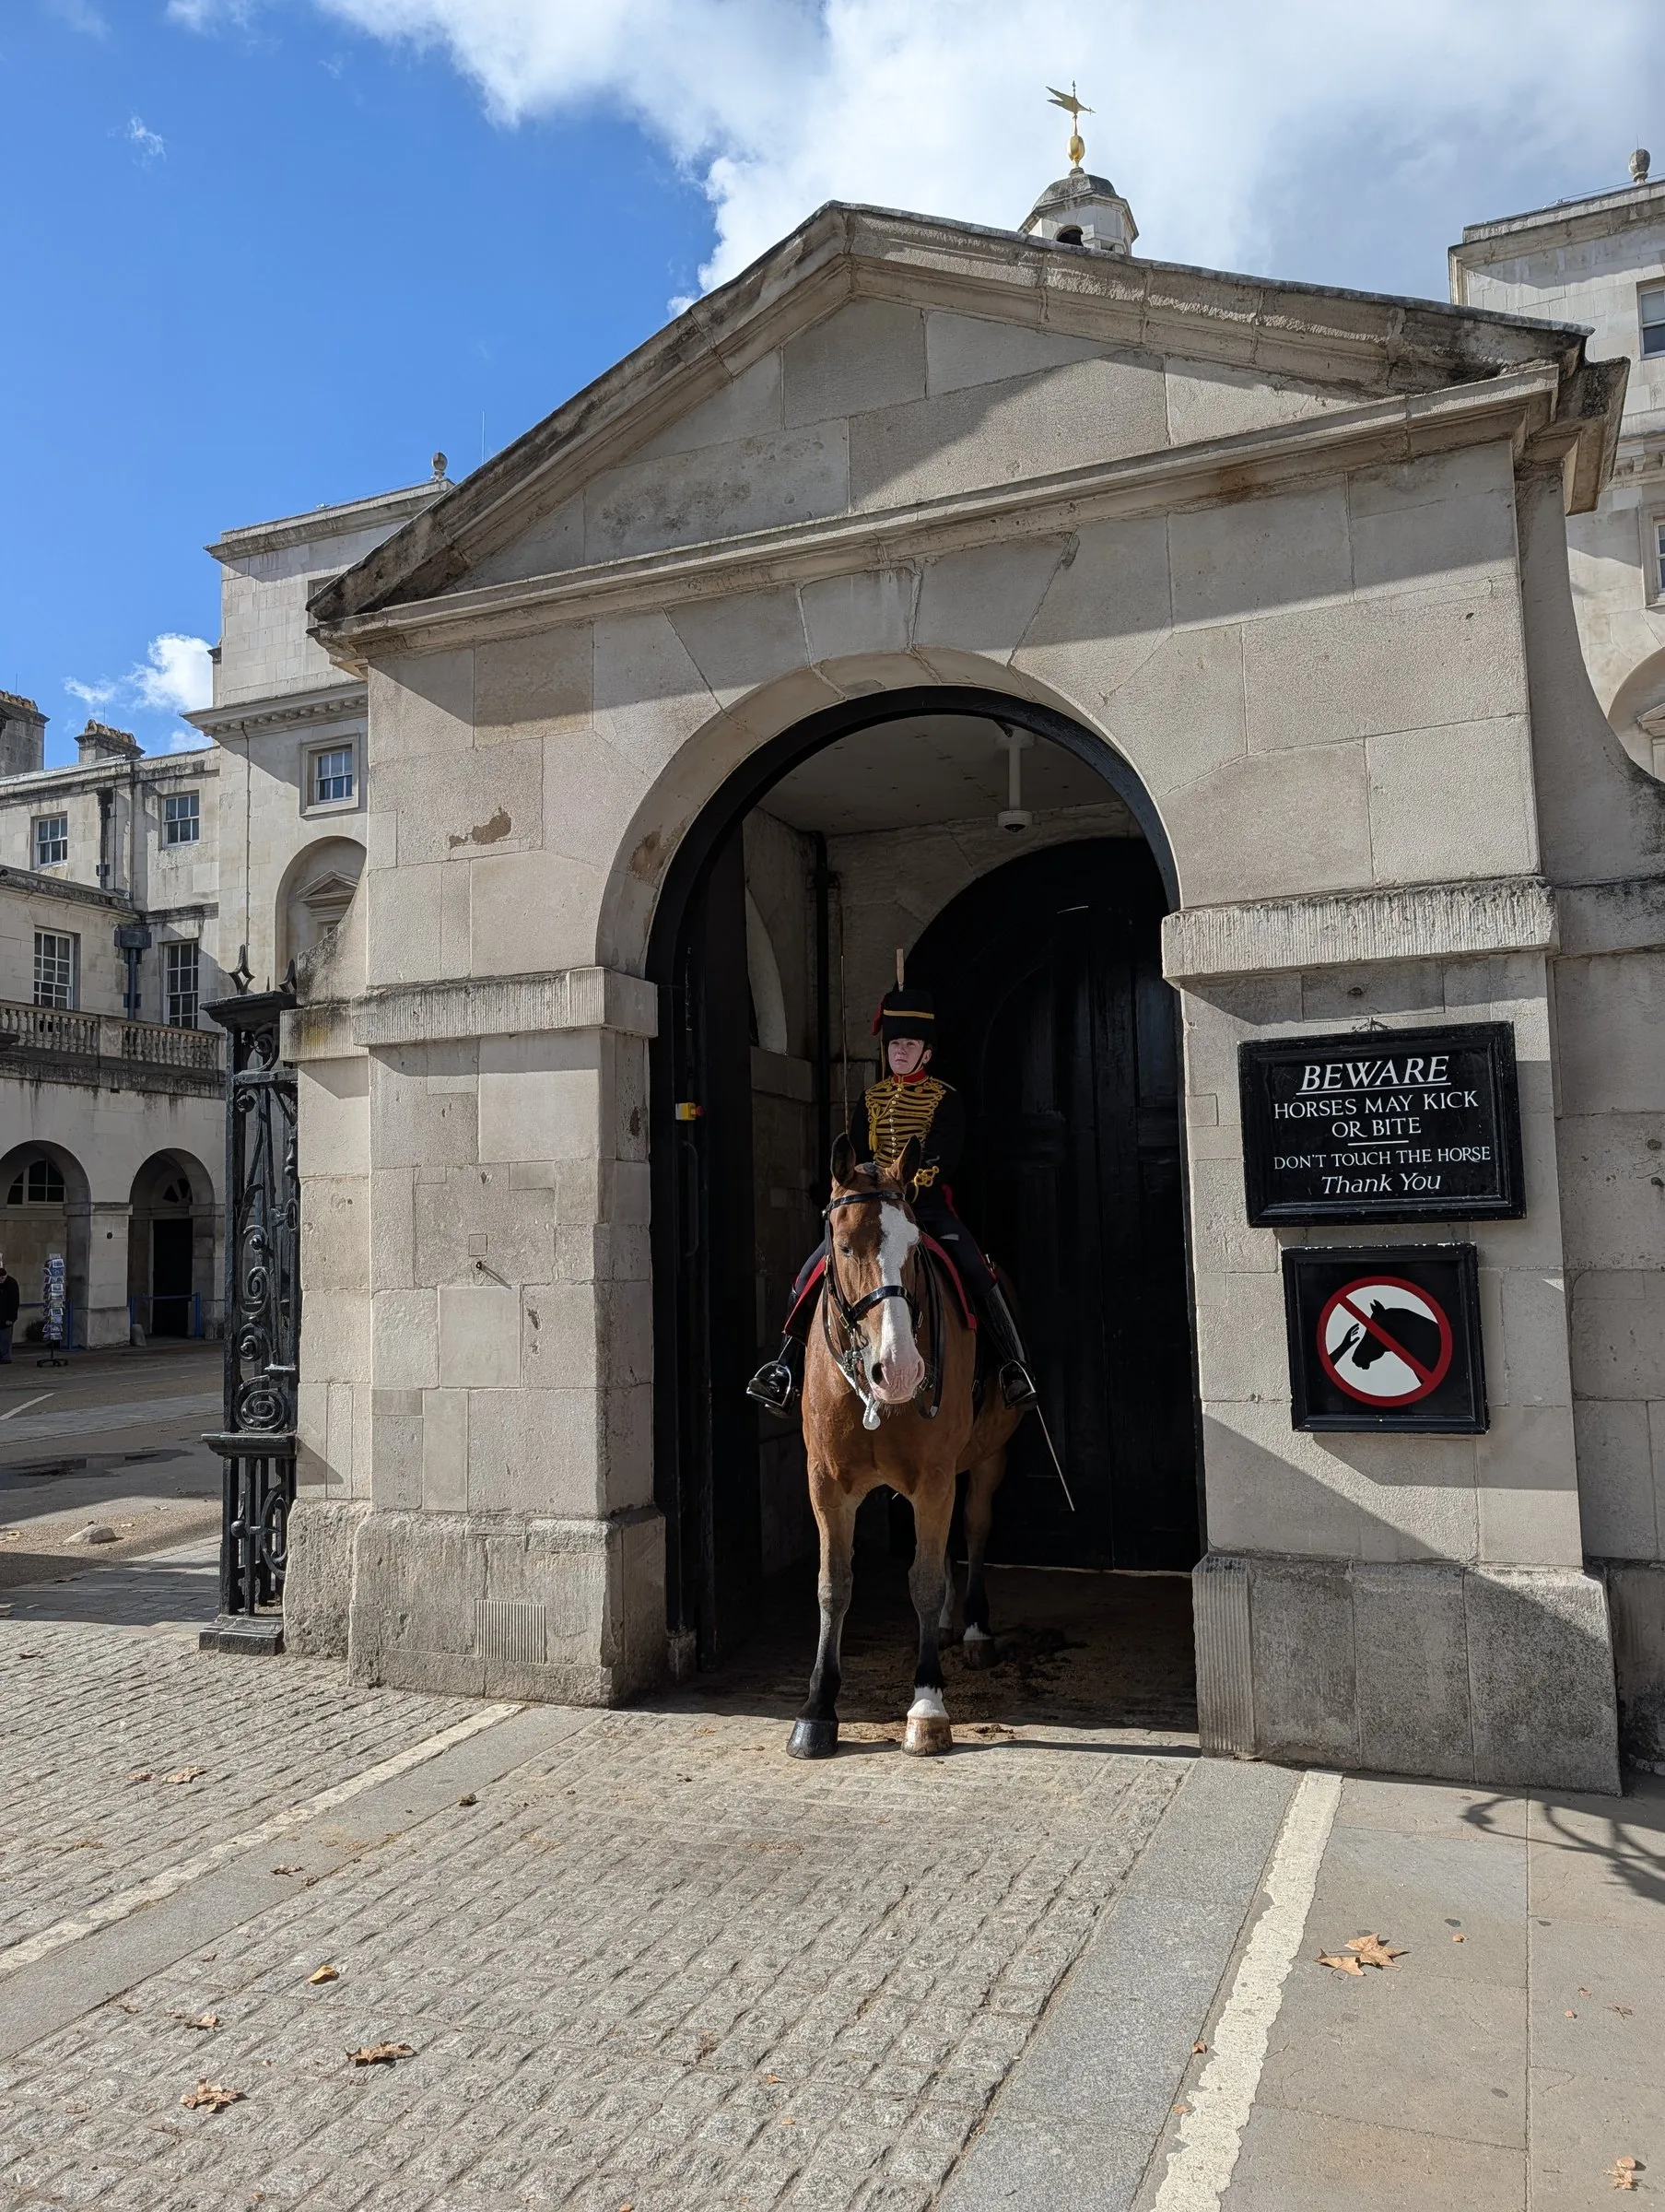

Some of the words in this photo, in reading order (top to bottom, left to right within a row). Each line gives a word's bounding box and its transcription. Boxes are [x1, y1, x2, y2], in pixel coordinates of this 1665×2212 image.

[1301, 1056, 1448, 1090] BEWARE
[1274, 1100, 1356, 1118] HORSES
[1366, 1095, 1413, 1112] MAY
[1424, 1091, 1478, 1110] KICK
[1332, 1122, 1367, 1137] OR
[1373, 1117, 1421, 1135] BITE
[1274, 1155, 1326, 1169] DON'T
[1331, 1151, 1390, 1166] TOUCH
[1396, 1149, 1432, 1163] THE
[1438, 1147, 1490, 1162] HORSE
[1322, 1174, 1391, 1194] Thank
[1401, 1173, 1440, 1190] You
